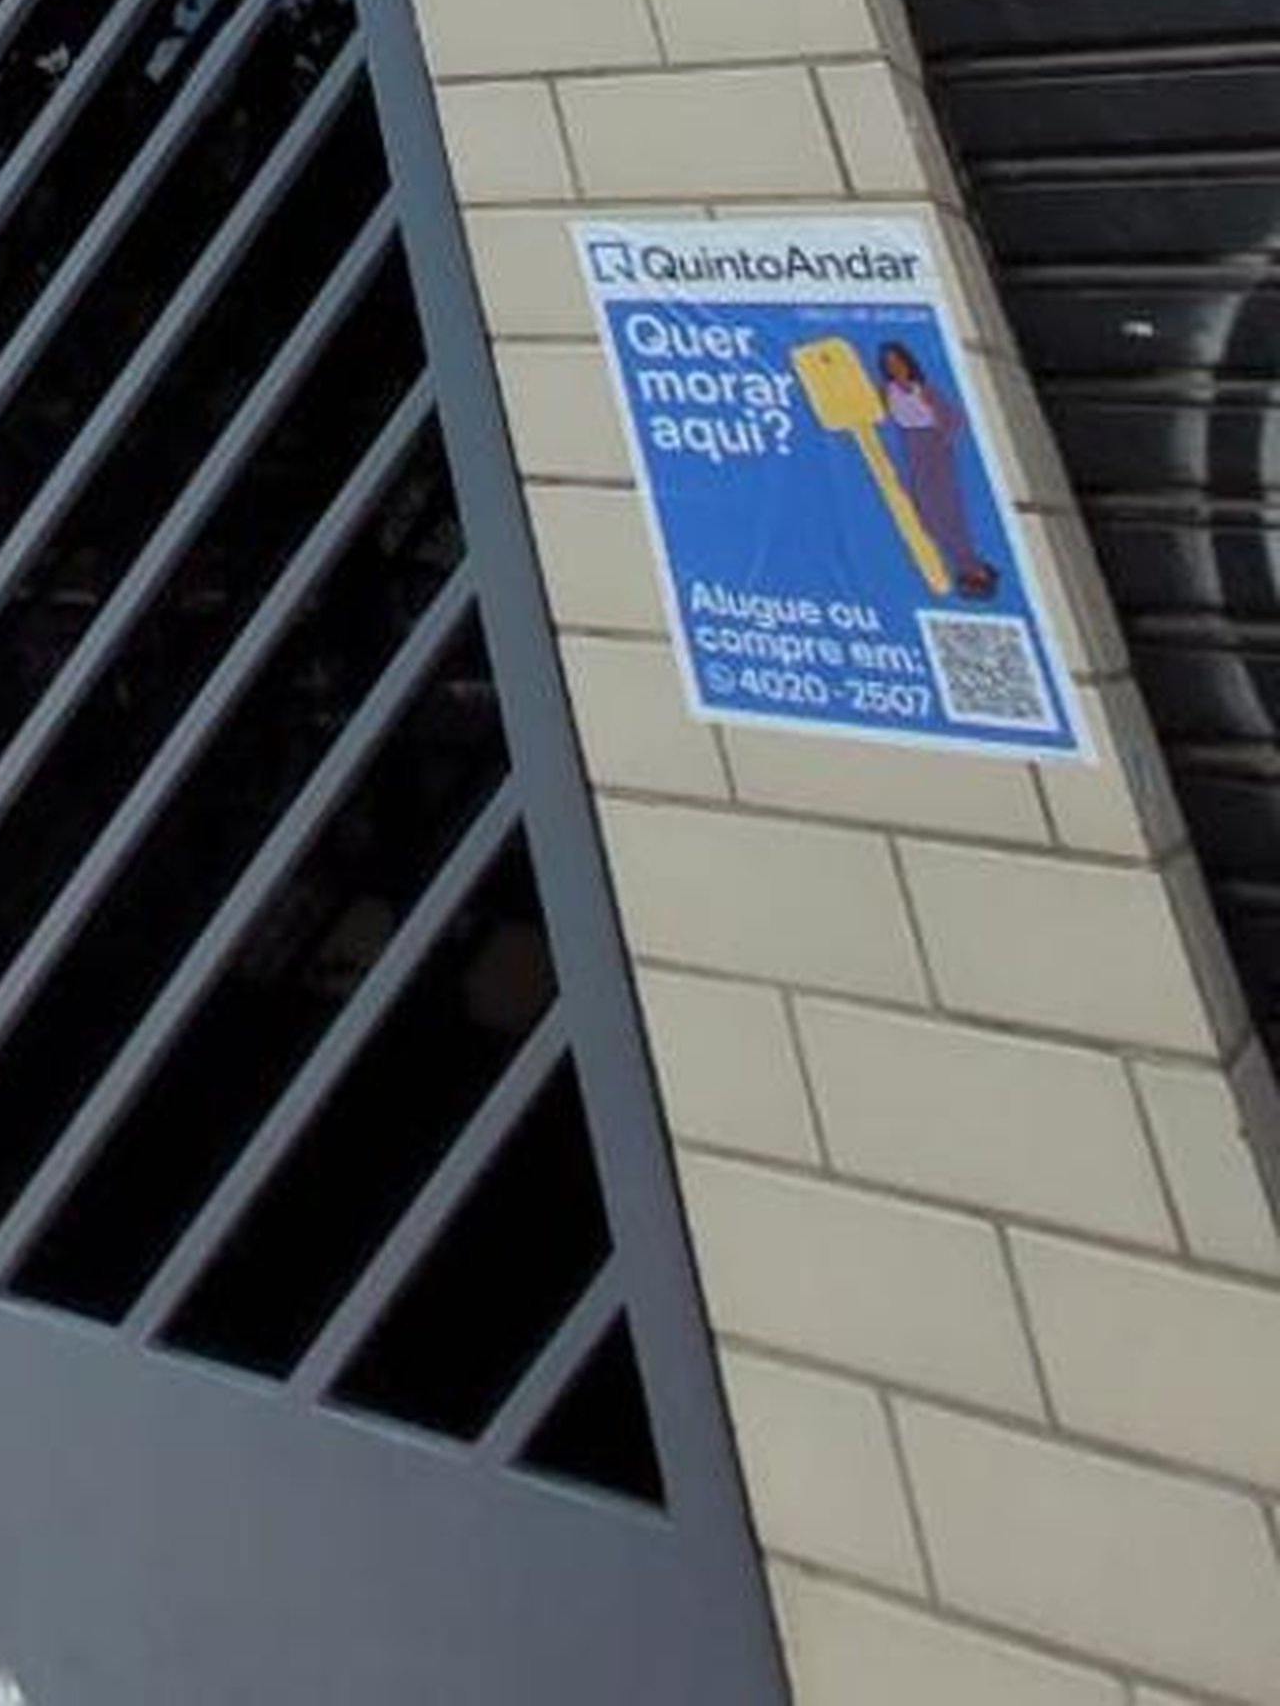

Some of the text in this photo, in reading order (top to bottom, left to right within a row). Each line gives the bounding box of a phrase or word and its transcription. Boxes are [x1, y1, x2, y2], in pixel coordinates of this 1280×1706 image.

[641, 244, 921, 283] QuintoAndar
[626, 312, 755, 360] Quer
[640, 368, 794, 407] morar
[649, 407, 792, 464] aqui?
[692, 581, 881, 631] Alugue ou
[695, 626, 927, 676] compre em:
